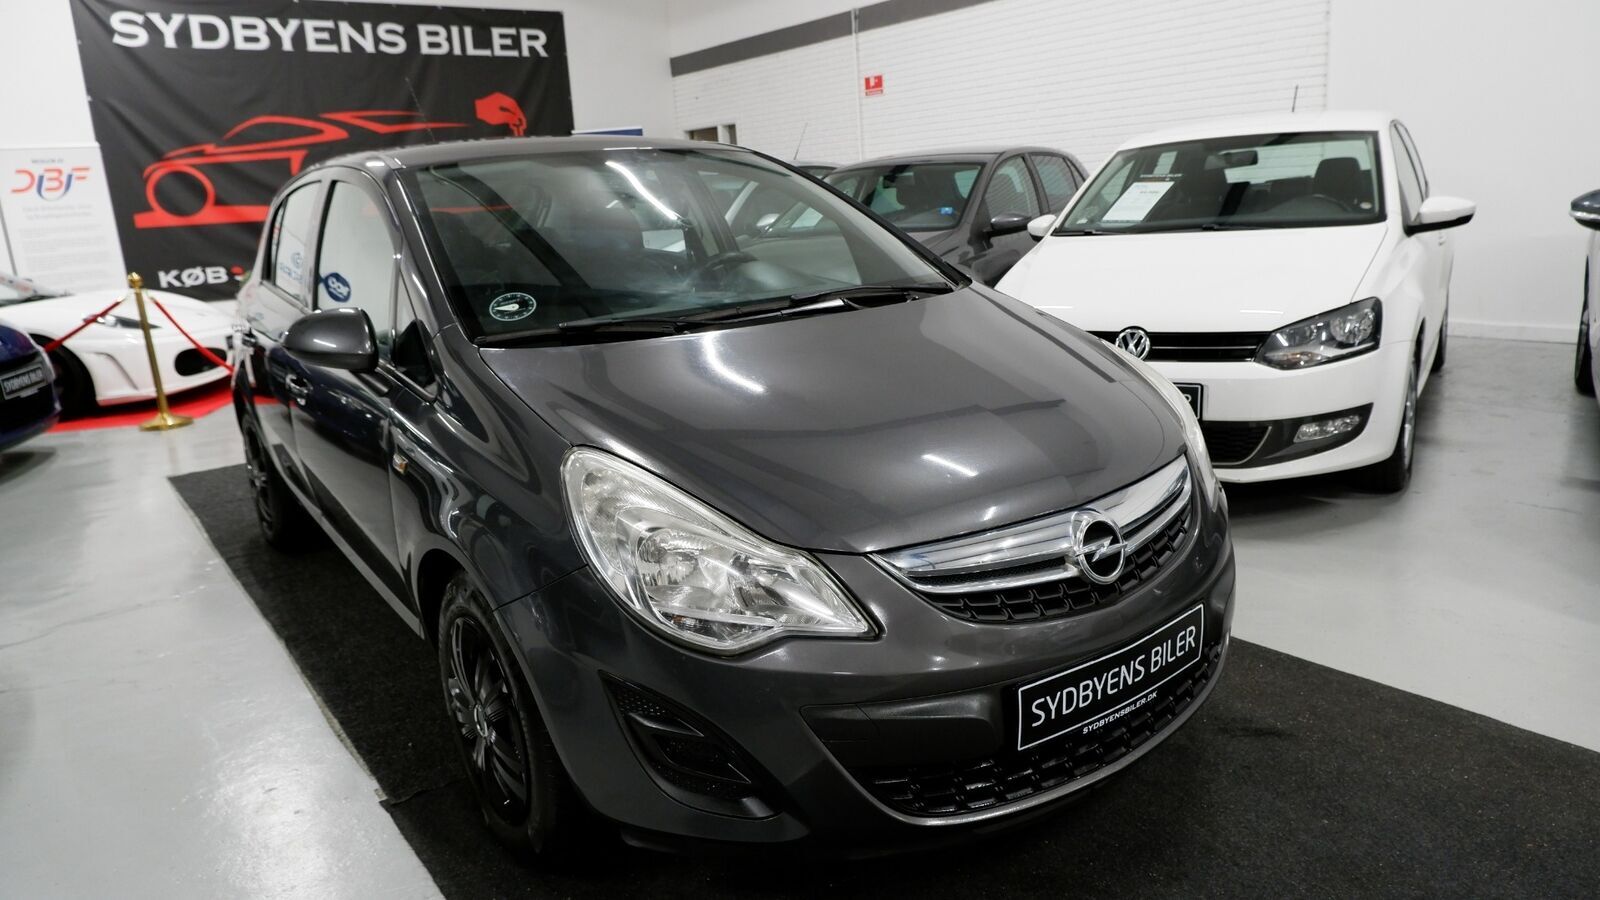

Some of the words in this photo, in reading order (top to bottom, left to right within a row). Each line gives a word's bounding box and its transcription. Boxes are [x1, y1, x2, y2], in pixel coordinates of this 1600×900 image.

[110, 10, 408, 55] SYDBYENS
[416, 23, 549, 58] BILER
[157, 265, 229, 289] KØB
[1031, 654, 1146, 727] SYDBYENS
[1150, 625, 1196, 673] BILER
[1082, 690, 1158, 735] SYDBYENSBILER.DK
